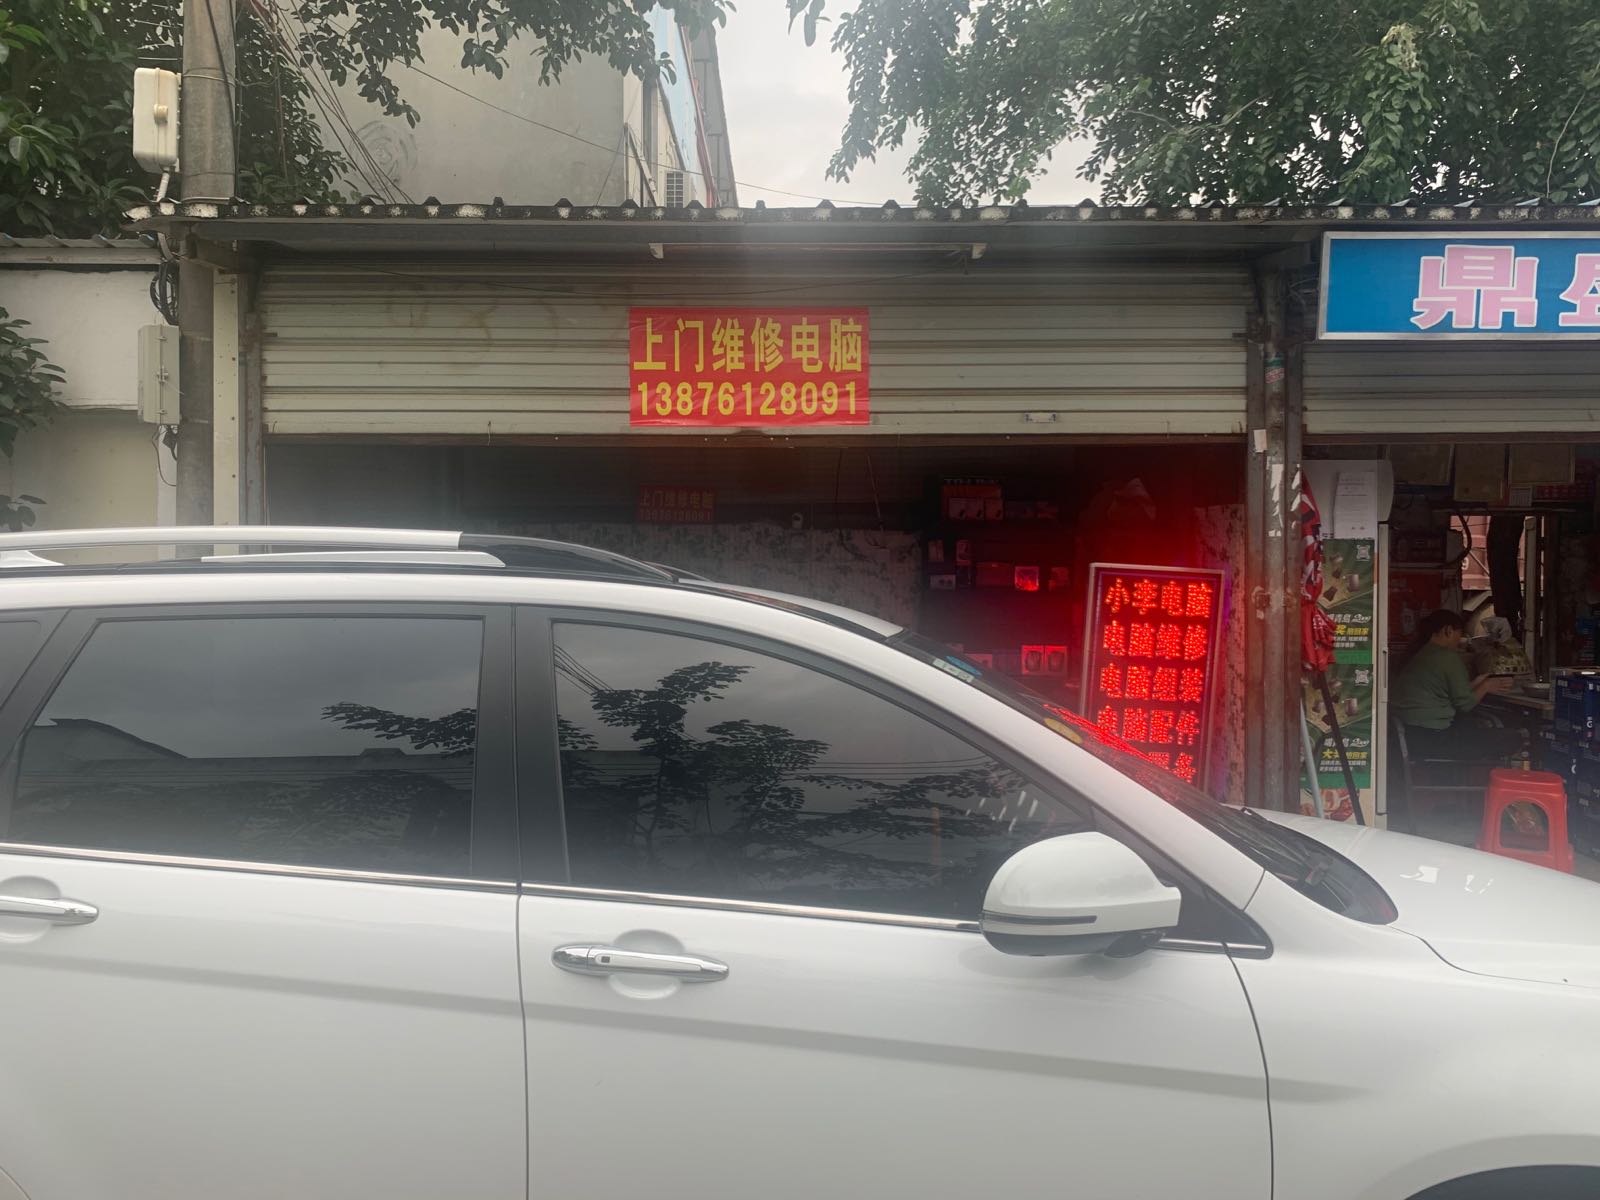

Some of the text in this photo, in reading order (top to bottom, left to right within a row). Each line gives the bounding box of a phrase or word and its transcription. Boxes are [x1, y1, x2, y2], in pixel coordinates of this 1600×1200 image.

[633, 316, 863, 373] 上门维修电脑
[637, 381, 857, 416] 13876128091
[1104, 577, 1213, 618] 小李电脑
[1102, 620, 1208, 661] 电脑维修
[1099, 662, 1205, 703] 电脑组装
[1096, 705, 1200, 746] 电脑配件
